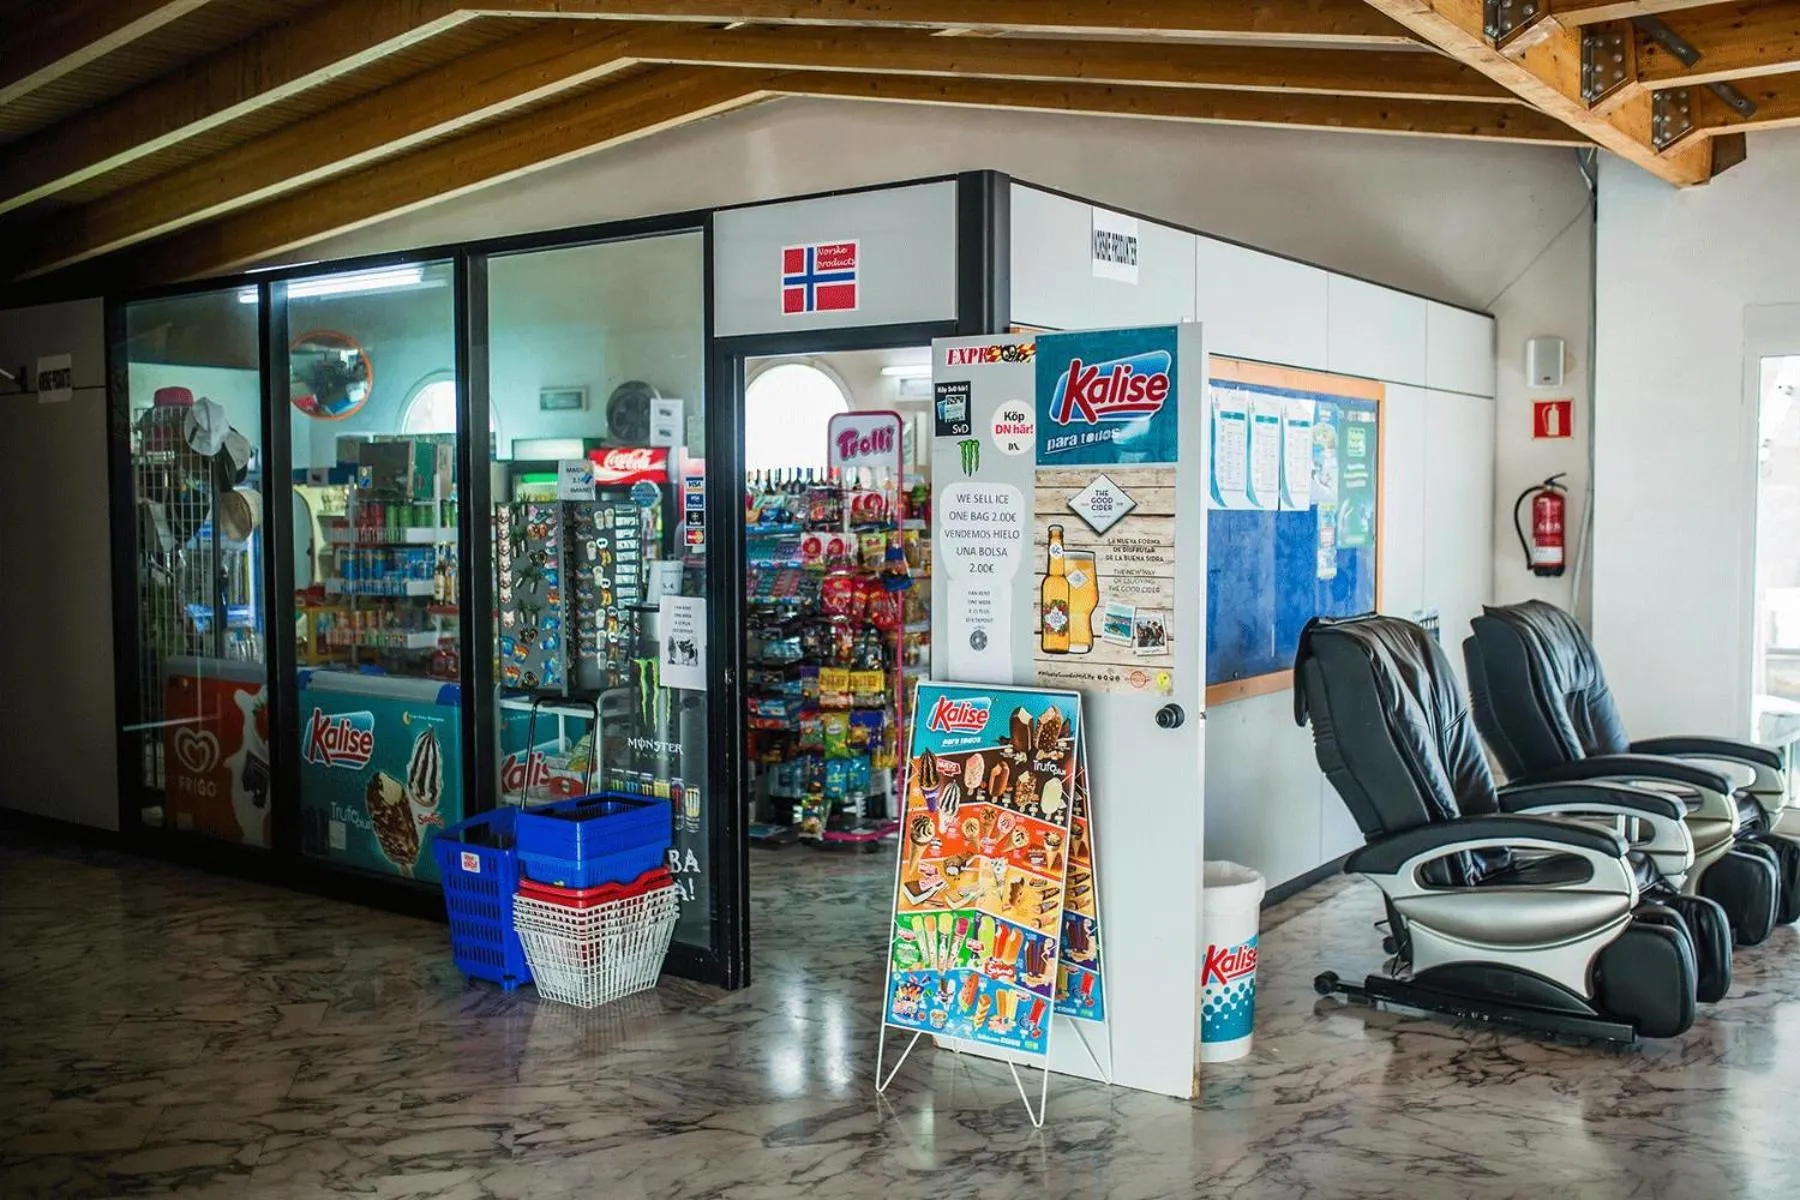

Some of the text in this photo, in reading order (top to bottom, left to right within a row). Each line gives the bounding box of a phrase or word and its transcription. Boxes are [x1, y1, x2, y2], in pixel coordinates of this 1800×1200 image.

[1060, 359, 1169, 425] Kalise
[1004, 411, 1025, 423] Köp
[952, 424, 969, 434] SvD
[995, 424, 1034, 434] DN här!
[837, 425, 895, 461] Trolli
[1047, 434, 1078, 451] para
[956, 493, 1009, 505] WE SELL ICE
[1095, 489, 1109, 497] THE
[1090, 496, 1114, 504] GOOD
[948, 511, 1017, 522] ONE BAG 2.00€
[944, 529, 1020, 540] VENDEMOS HIELO
[956, 546, 1008, 557] UNA BOLSA
[969, 562, 995, 573] 2.00€
[932, 695, 989, 732] Kalise
[308, 707, 373, 767] Kalise
[627, 736, 684, 756] MONSTER
[178, 775, 217, 798] FRIGO
[668, 847, 701, 873] BA
[1200, 943, 1257, 987] Kalis
